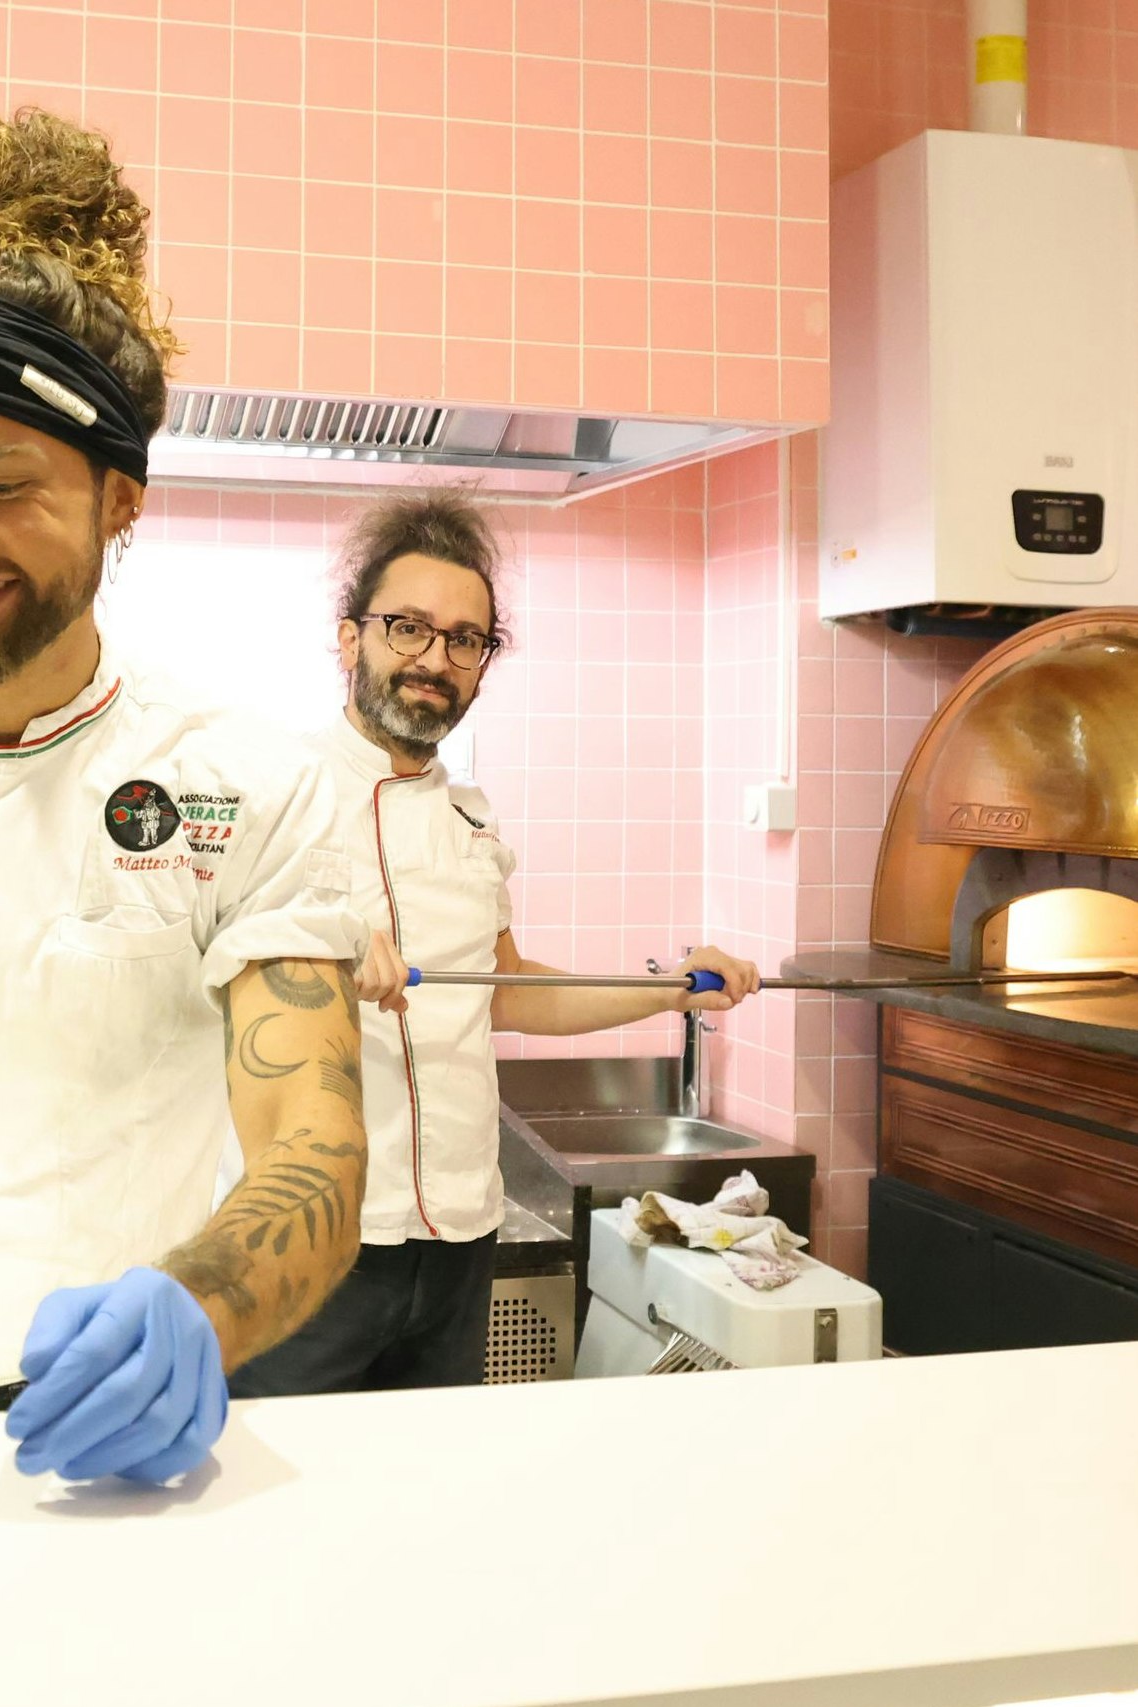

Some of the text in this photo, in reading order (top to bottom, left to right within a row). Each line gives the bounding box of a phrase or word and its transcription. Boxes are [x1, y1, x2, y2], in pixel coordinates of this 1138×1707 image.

[177, 793, 240, 805] ASSOCIAZIONE
[178, 806, 238, 822] VERACE
[182, 822, 232, 840] PZZA
[113, 857, 169, 870] Matteo
